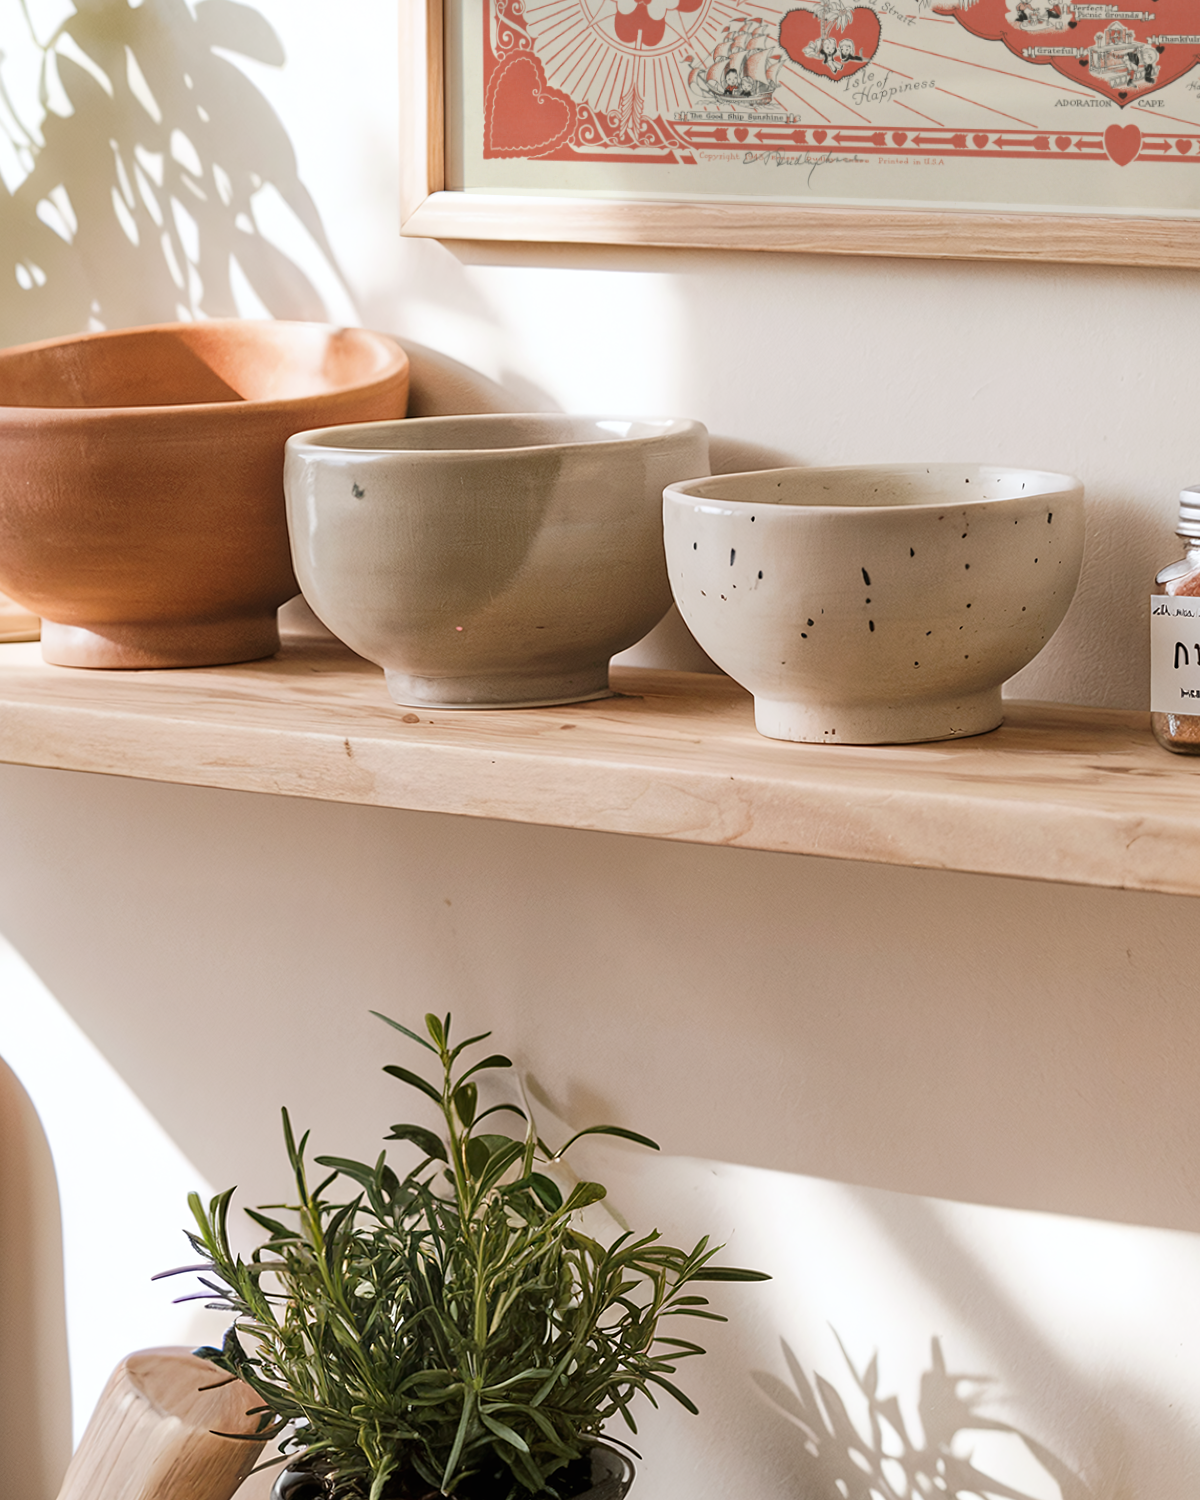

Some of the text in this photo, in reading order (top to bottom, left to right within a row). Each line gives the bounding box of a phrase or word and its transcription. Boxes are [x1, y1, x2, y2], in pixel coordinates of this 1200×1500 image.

[1072, 4, 1104, 13] Perfect
[1076, 10, 1140, 20] Picnic Grounds
[1036, 46, 1075, 56] Grateful
[842, 68, 895, 92] Isle of
[851, 78, 937, 106] Happiness
[1054, 98, 1166, 109] ADORATION CAPE
[689, 111, 784, 122] The Good Ship Sunshine
